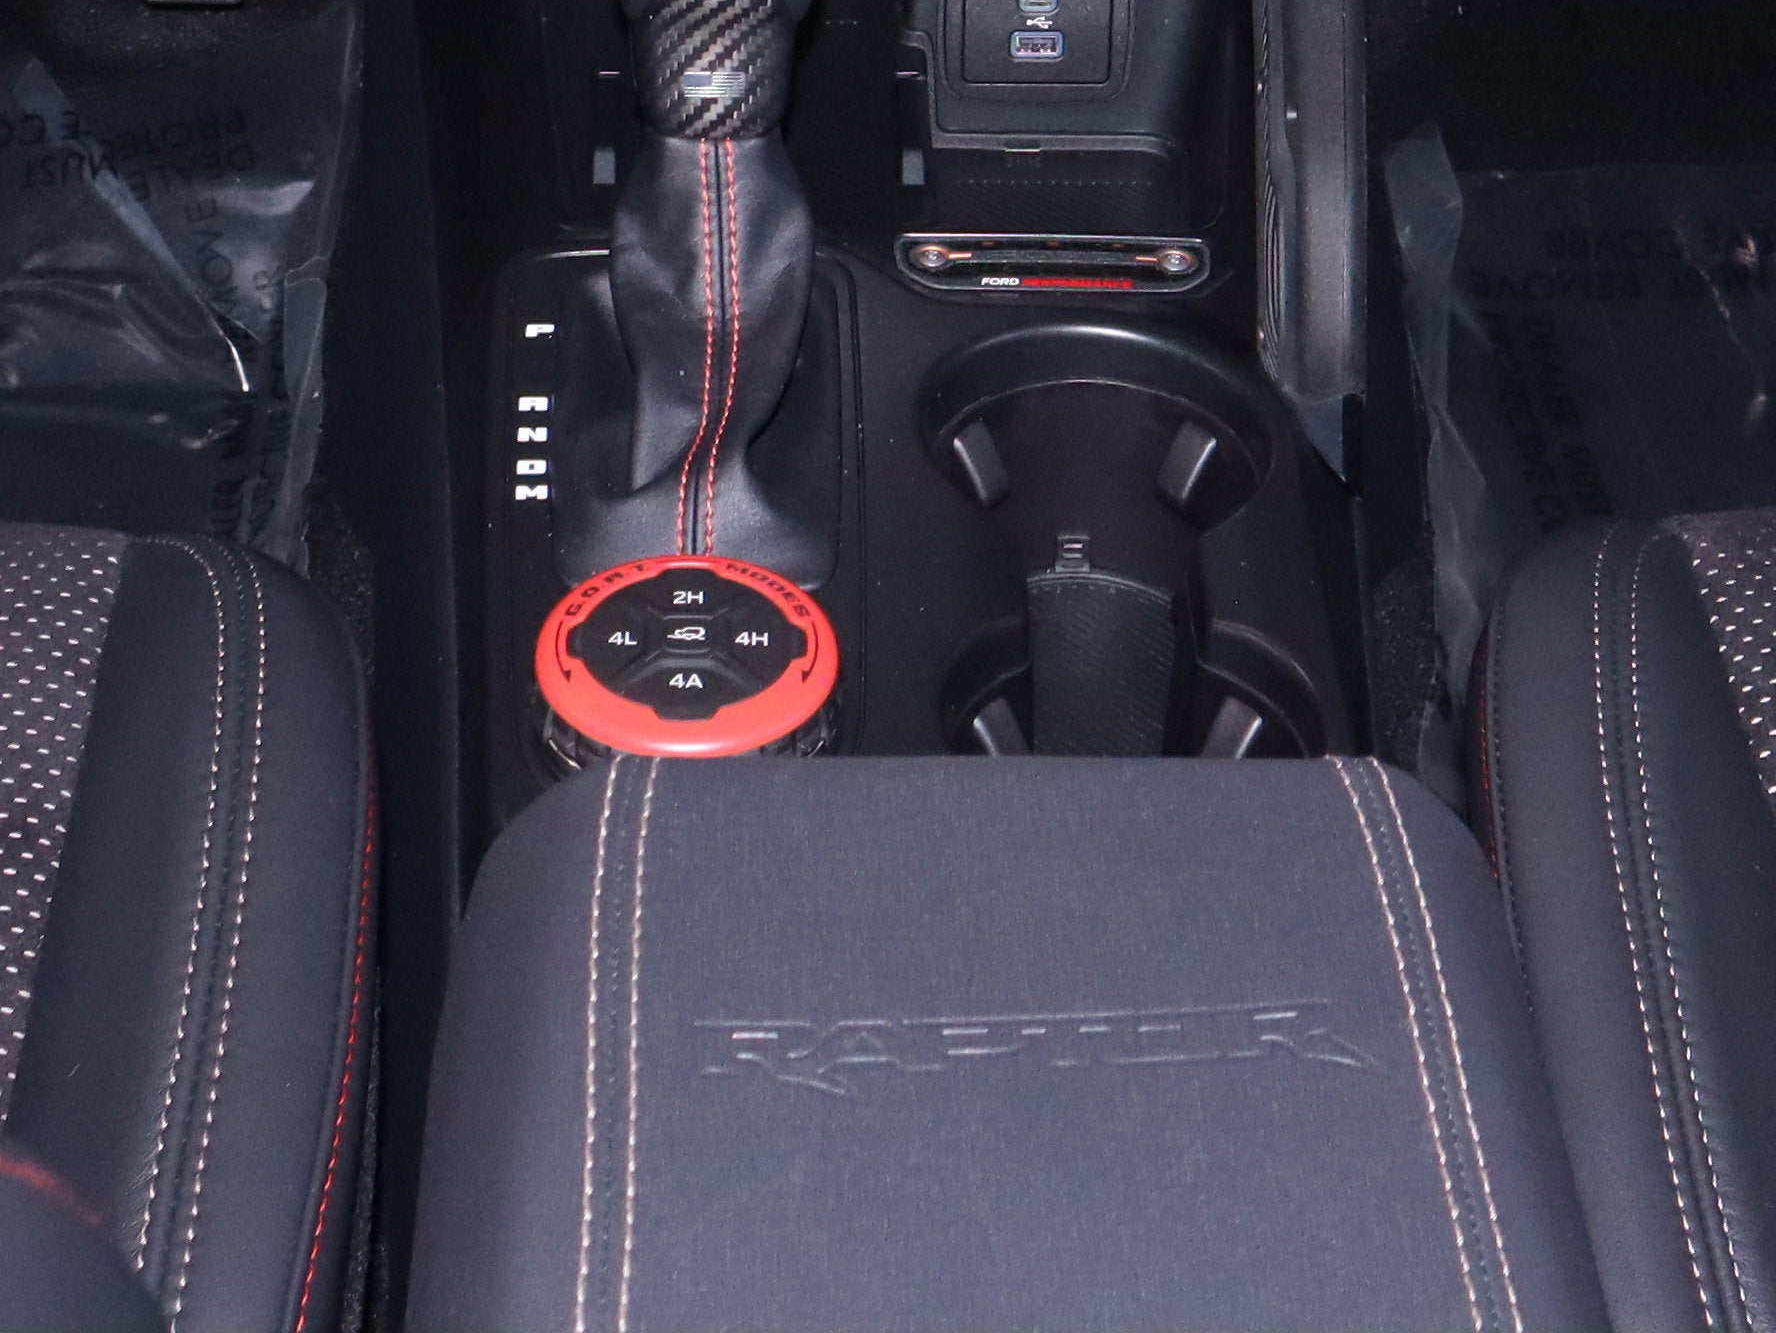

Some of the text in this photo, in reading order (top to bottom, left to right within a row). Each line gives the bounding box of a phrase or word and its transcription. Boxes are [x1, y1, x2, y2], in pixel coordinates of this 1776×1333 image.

[981, 277, 1021, 286] FORD
[524, 323, 555, 338] P
[517, 426, 548, 442] N
[515, 459, 548, 475] D
[515, 484, 548, 501] M
[673, 591, 704, 605] 2H
[725, 563, 811, 619] MODES
[608, 631, 638, 646] 4L
[734, 632, 769, 647] 4H
[669, 674, 703, 689] 4A
[693, 997, 1386, 1095] RAPTOR
